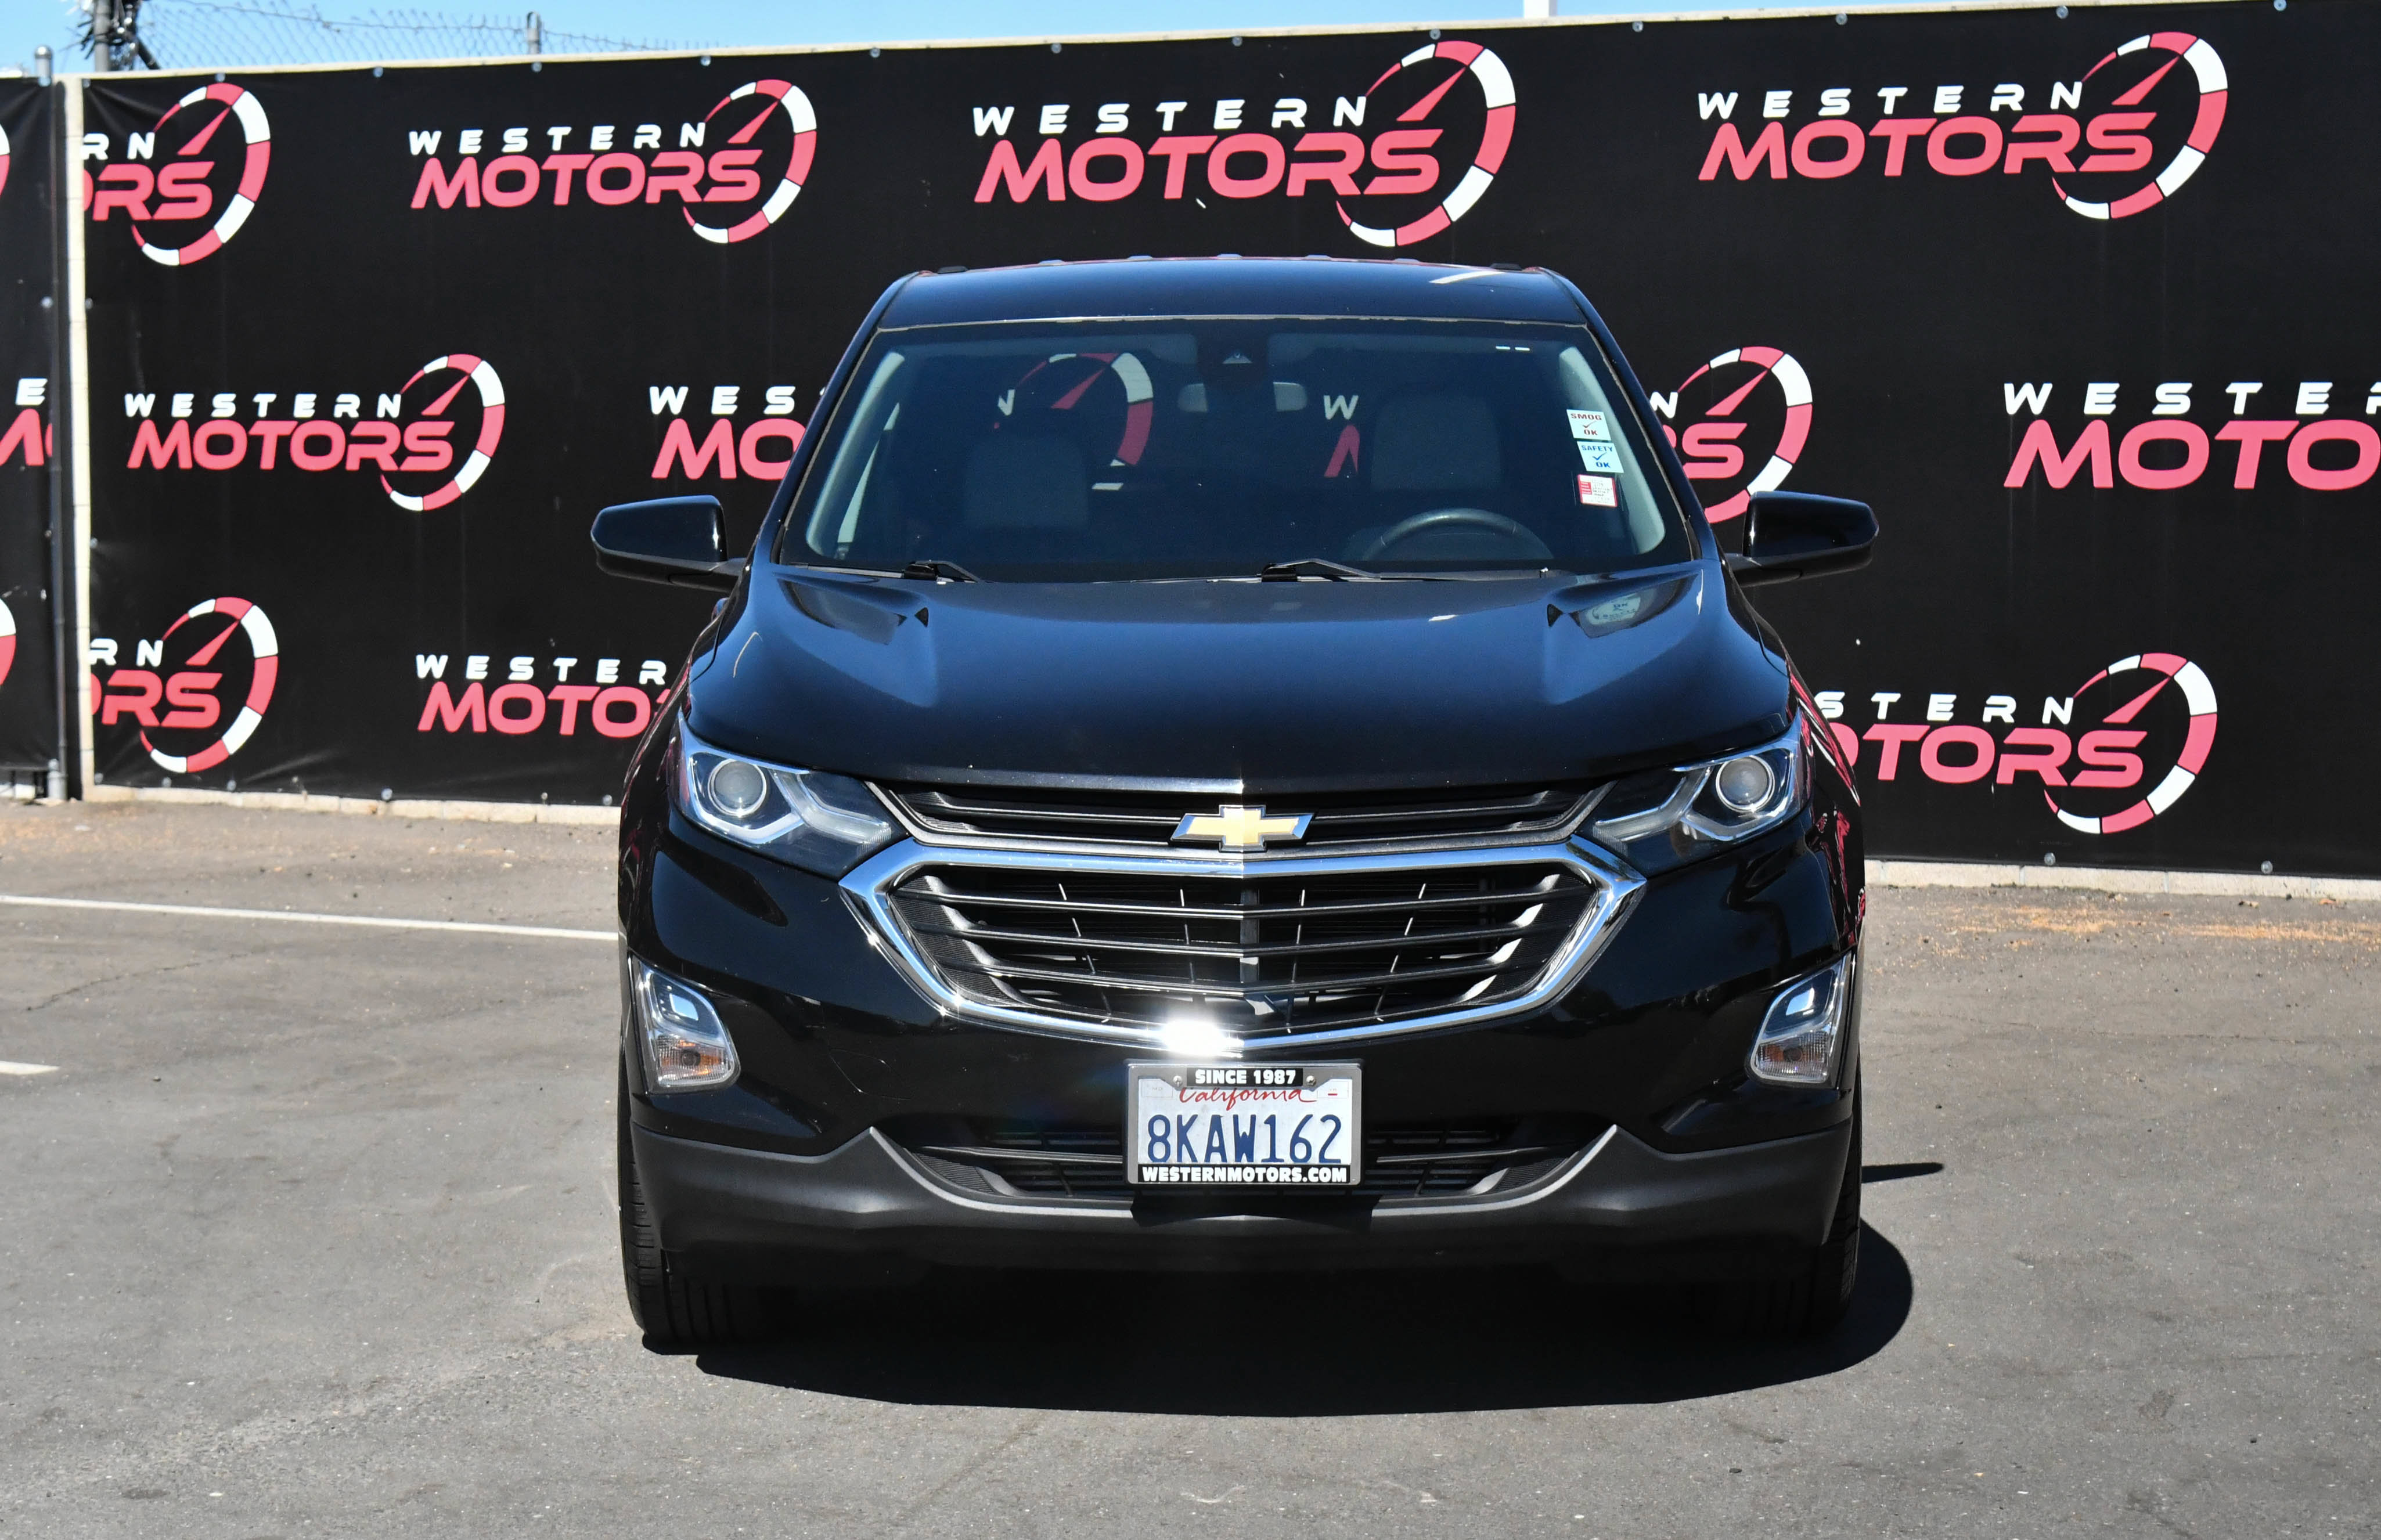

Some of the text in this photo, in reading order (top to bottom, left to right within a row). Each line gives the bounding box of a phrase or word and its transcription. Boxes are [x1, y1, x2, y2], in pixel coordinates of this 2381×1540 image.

[972, 96, 1367, 137] WESTERN
[1698, 81, 2083, 120] WESTERN
[409, 122, 706, 156] WESTERN
[1698, 111, 2157, 181] MOTORS
[410, 149, 763, 210] MOTORS
[974, 128, 1444, 203] MOTORS
[124, 393, 402, 419] WESTERN
[649, 385, 826, 415] WES
[1570, 413, 1602, 421] SMOG
[127, 419, 455, 471] MOTORS
[416, 654, 667, 686] WESTER
[1194, 1069, 1296, 1084] SINCE 1987
[1179, 1087, 1317, 1110] California
[1147, 1114, 1342, 1163] 8KAW162
[1142, 1166, 1347, 1182] WESTERNMOTORS.COM
